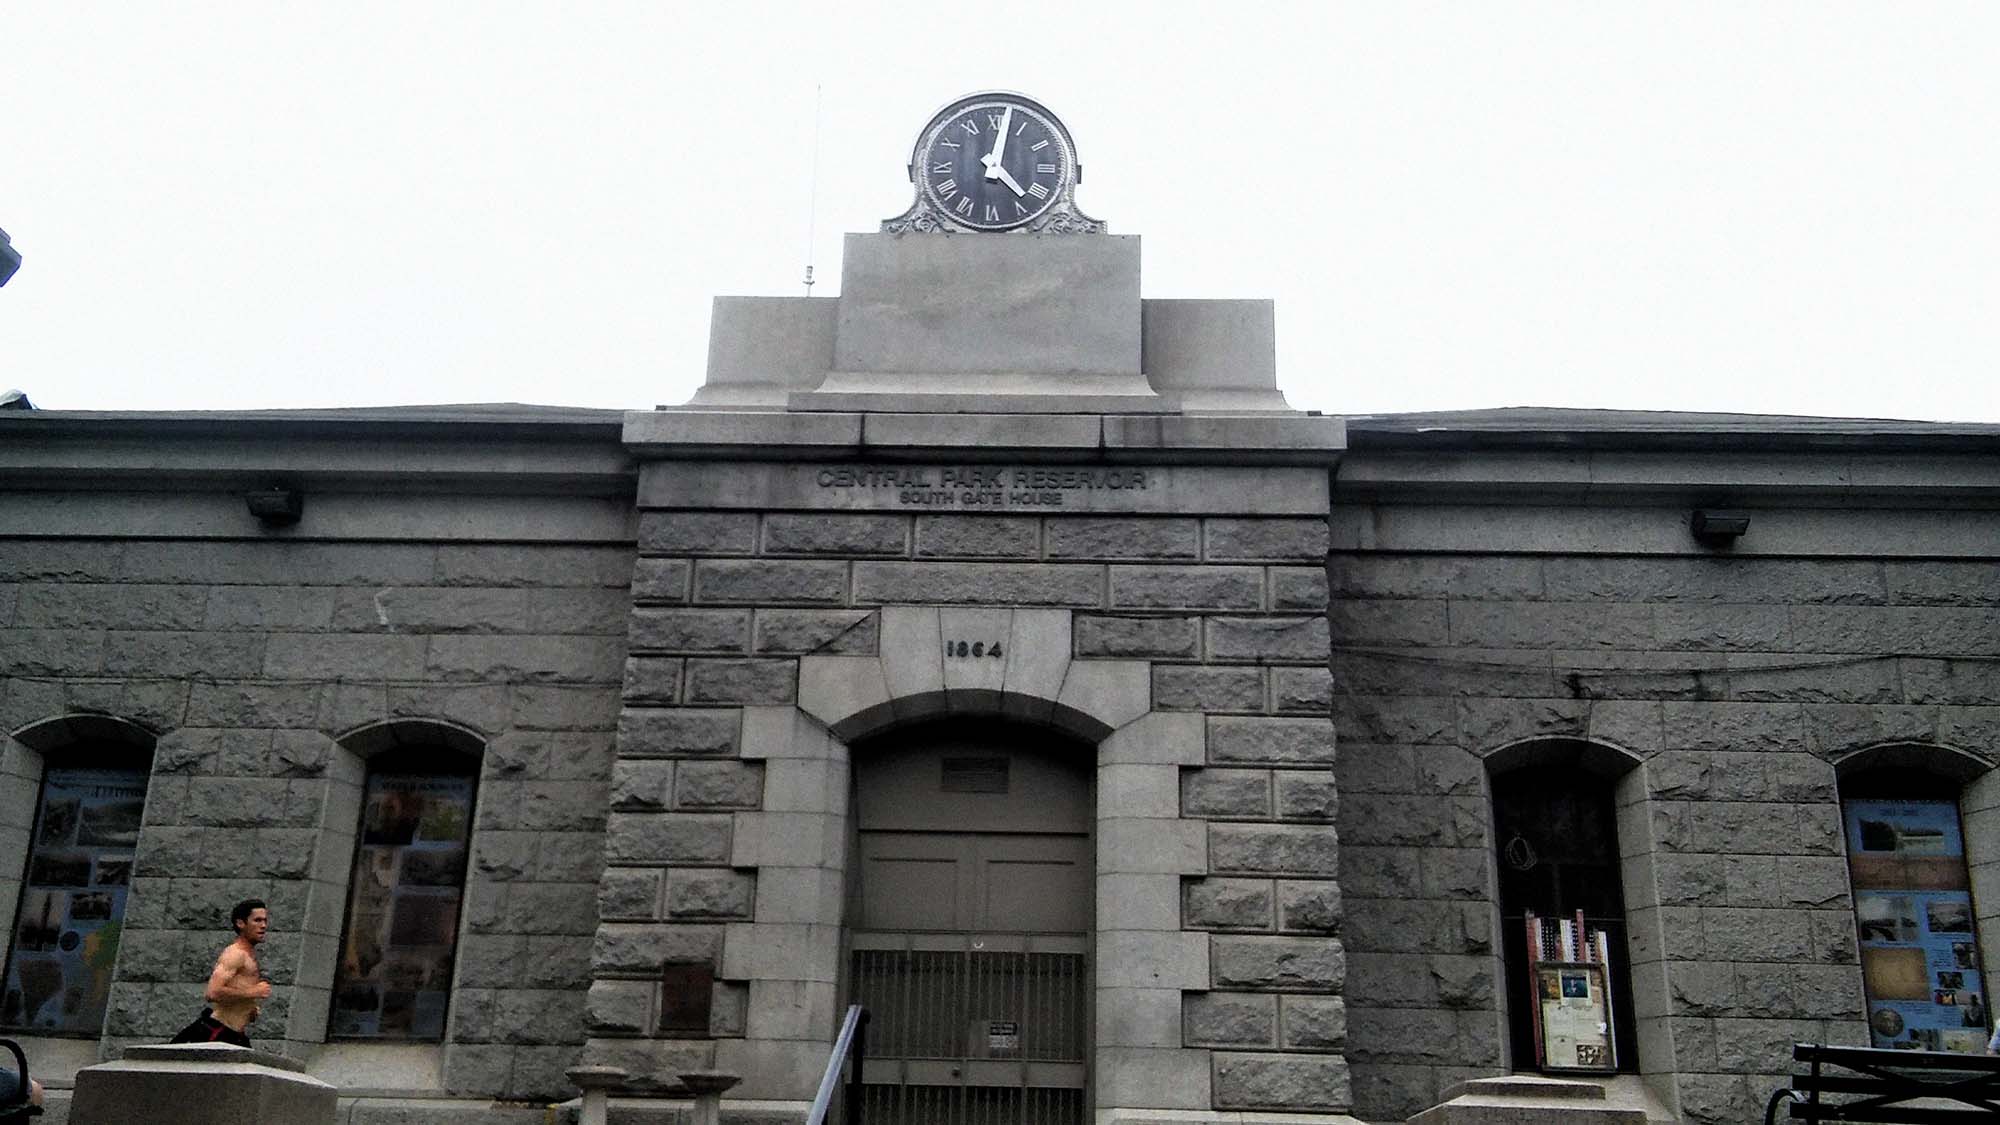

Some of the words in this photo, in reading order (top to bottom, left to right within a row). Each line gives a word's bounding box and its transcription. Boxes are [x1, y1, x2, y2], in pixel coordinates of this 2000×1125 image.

[817, 470, 931, 488] CENTRAL
[940, 471, 1003, 488] PARK
[1013, 472, 1147, 490] RESERVOIR
[900, 491, 955, 505] SOUTH
[961, 491, 1002, 505] GATE
[1009, 492, 1063, 506] HOUSE
[947, 640, 1003, 659] 1864
